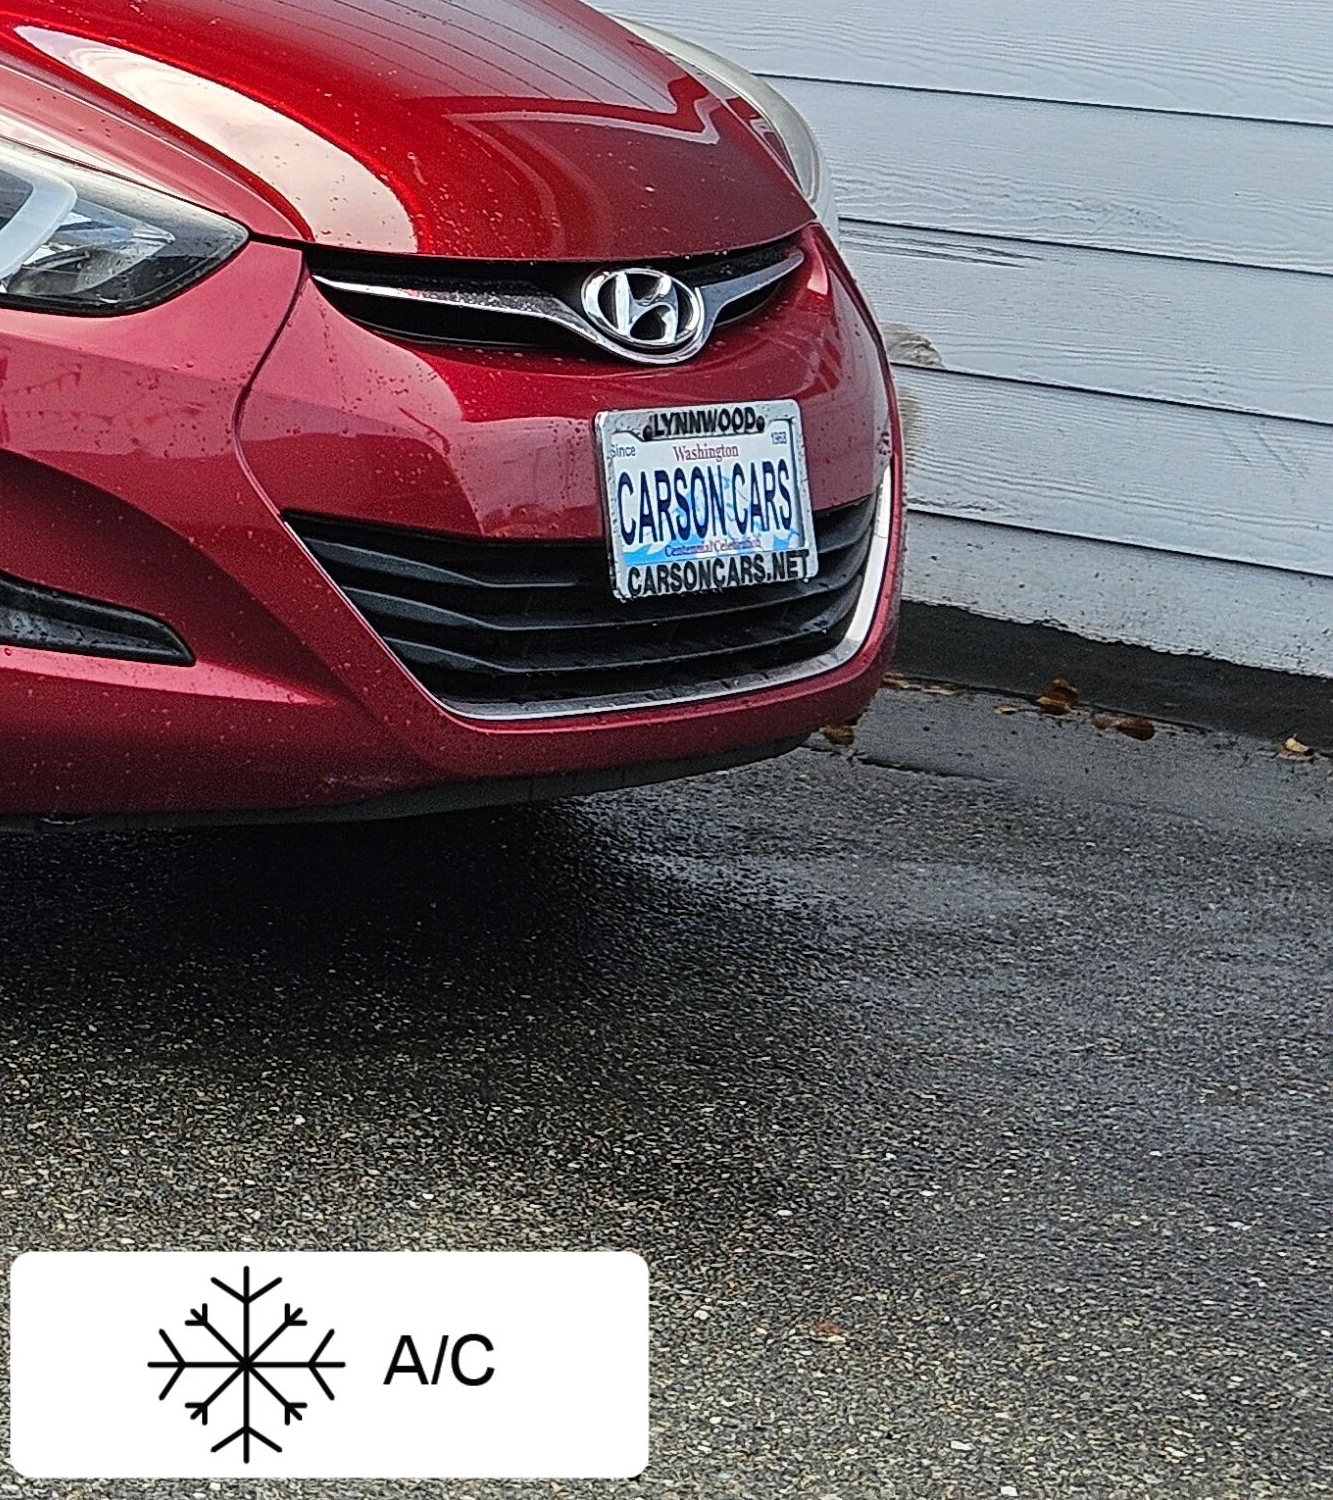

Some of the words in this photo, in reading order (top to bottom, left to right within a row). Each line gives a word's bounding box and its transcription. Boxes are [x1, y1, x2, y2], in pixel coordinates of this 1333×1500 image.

[651, 406, 757, 437] LYNNWOOD
[672, 443, 740, 462] Washington
[617, 464, 727, 546] CARSON
[733, 458, 793, 535] CARS
[627, 549, 811, 596] CARSONCARS.NET
